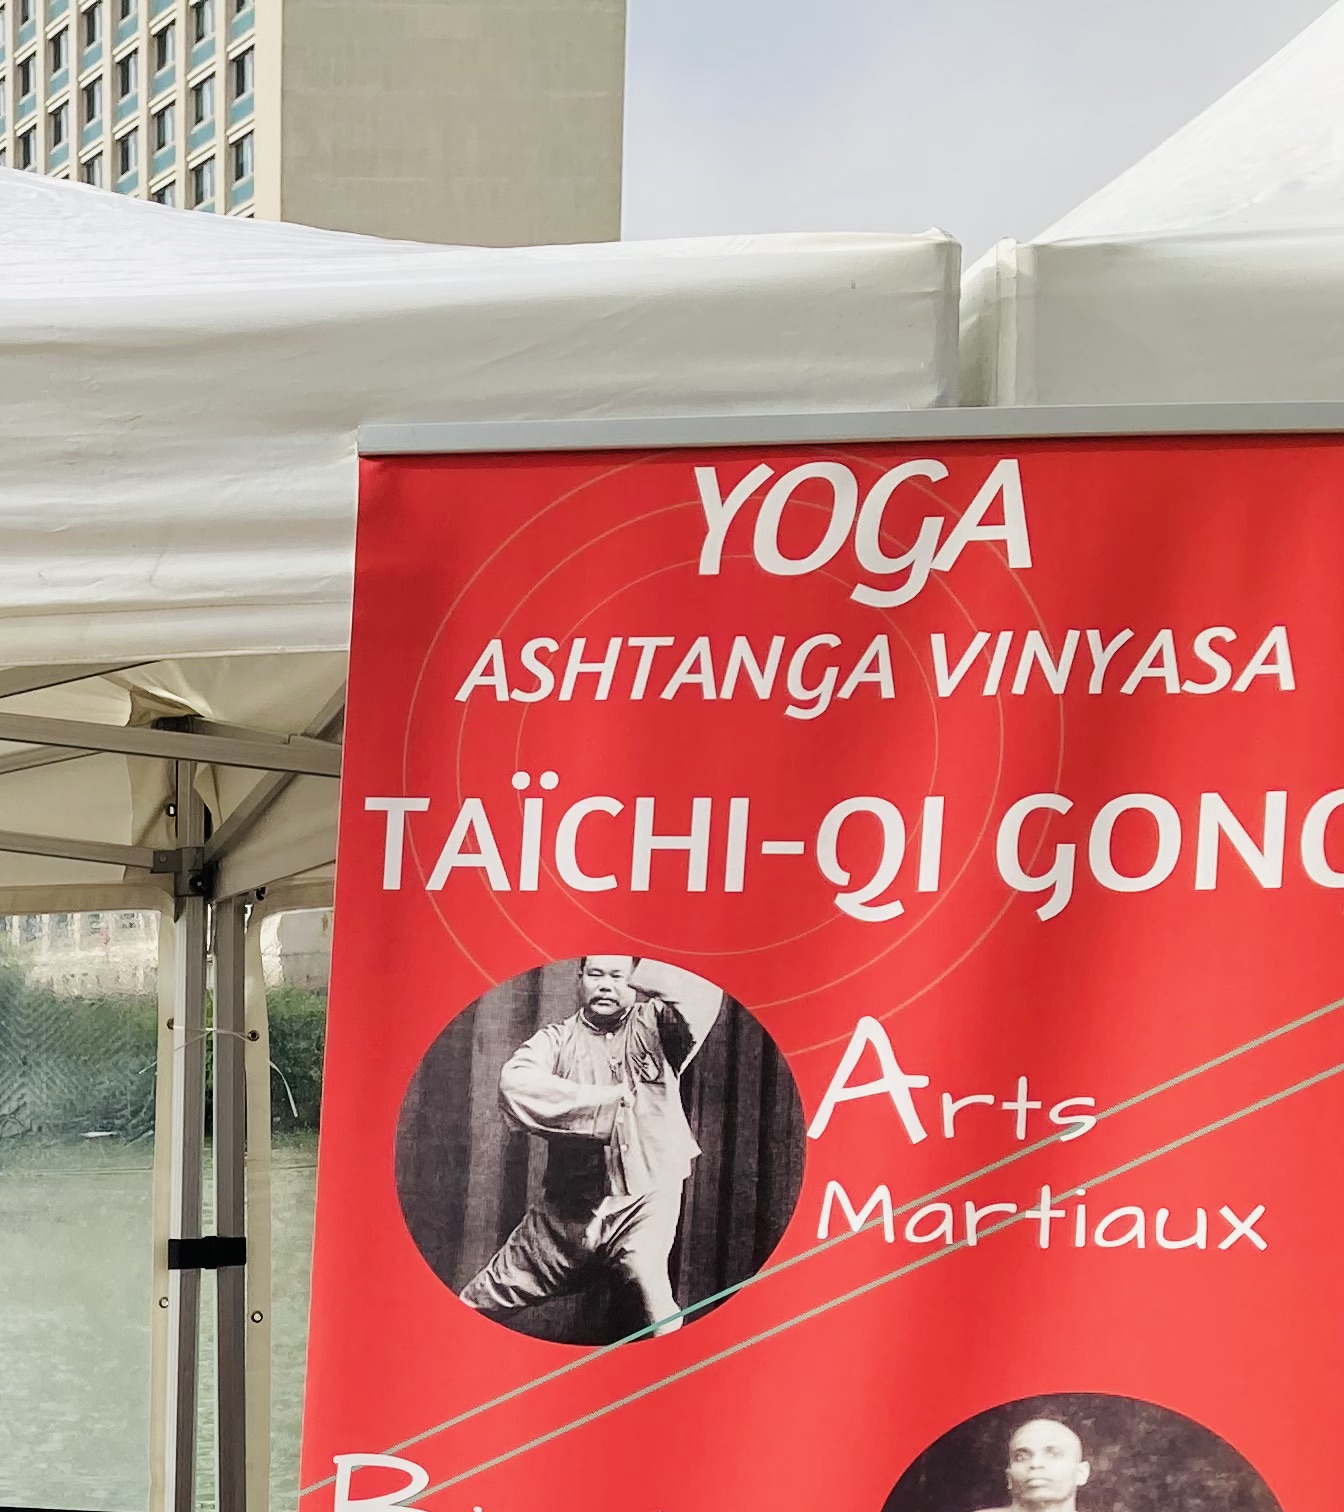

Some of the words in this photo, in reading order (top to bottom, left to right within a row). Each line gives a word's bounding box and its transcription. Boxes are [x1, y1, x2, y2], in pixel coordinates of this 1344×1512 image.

[694, 457, 1032, 608] YOGA
[456, 633, 896, 720] ASHTANGA
[931, 625, 1297, 697] VINYASA
[364, 770, 944, 922] TAÏCHI-QI
[807, 1015, 1099, 1144] Arts
[817, 1181, 1269, 1252] Martiaux
